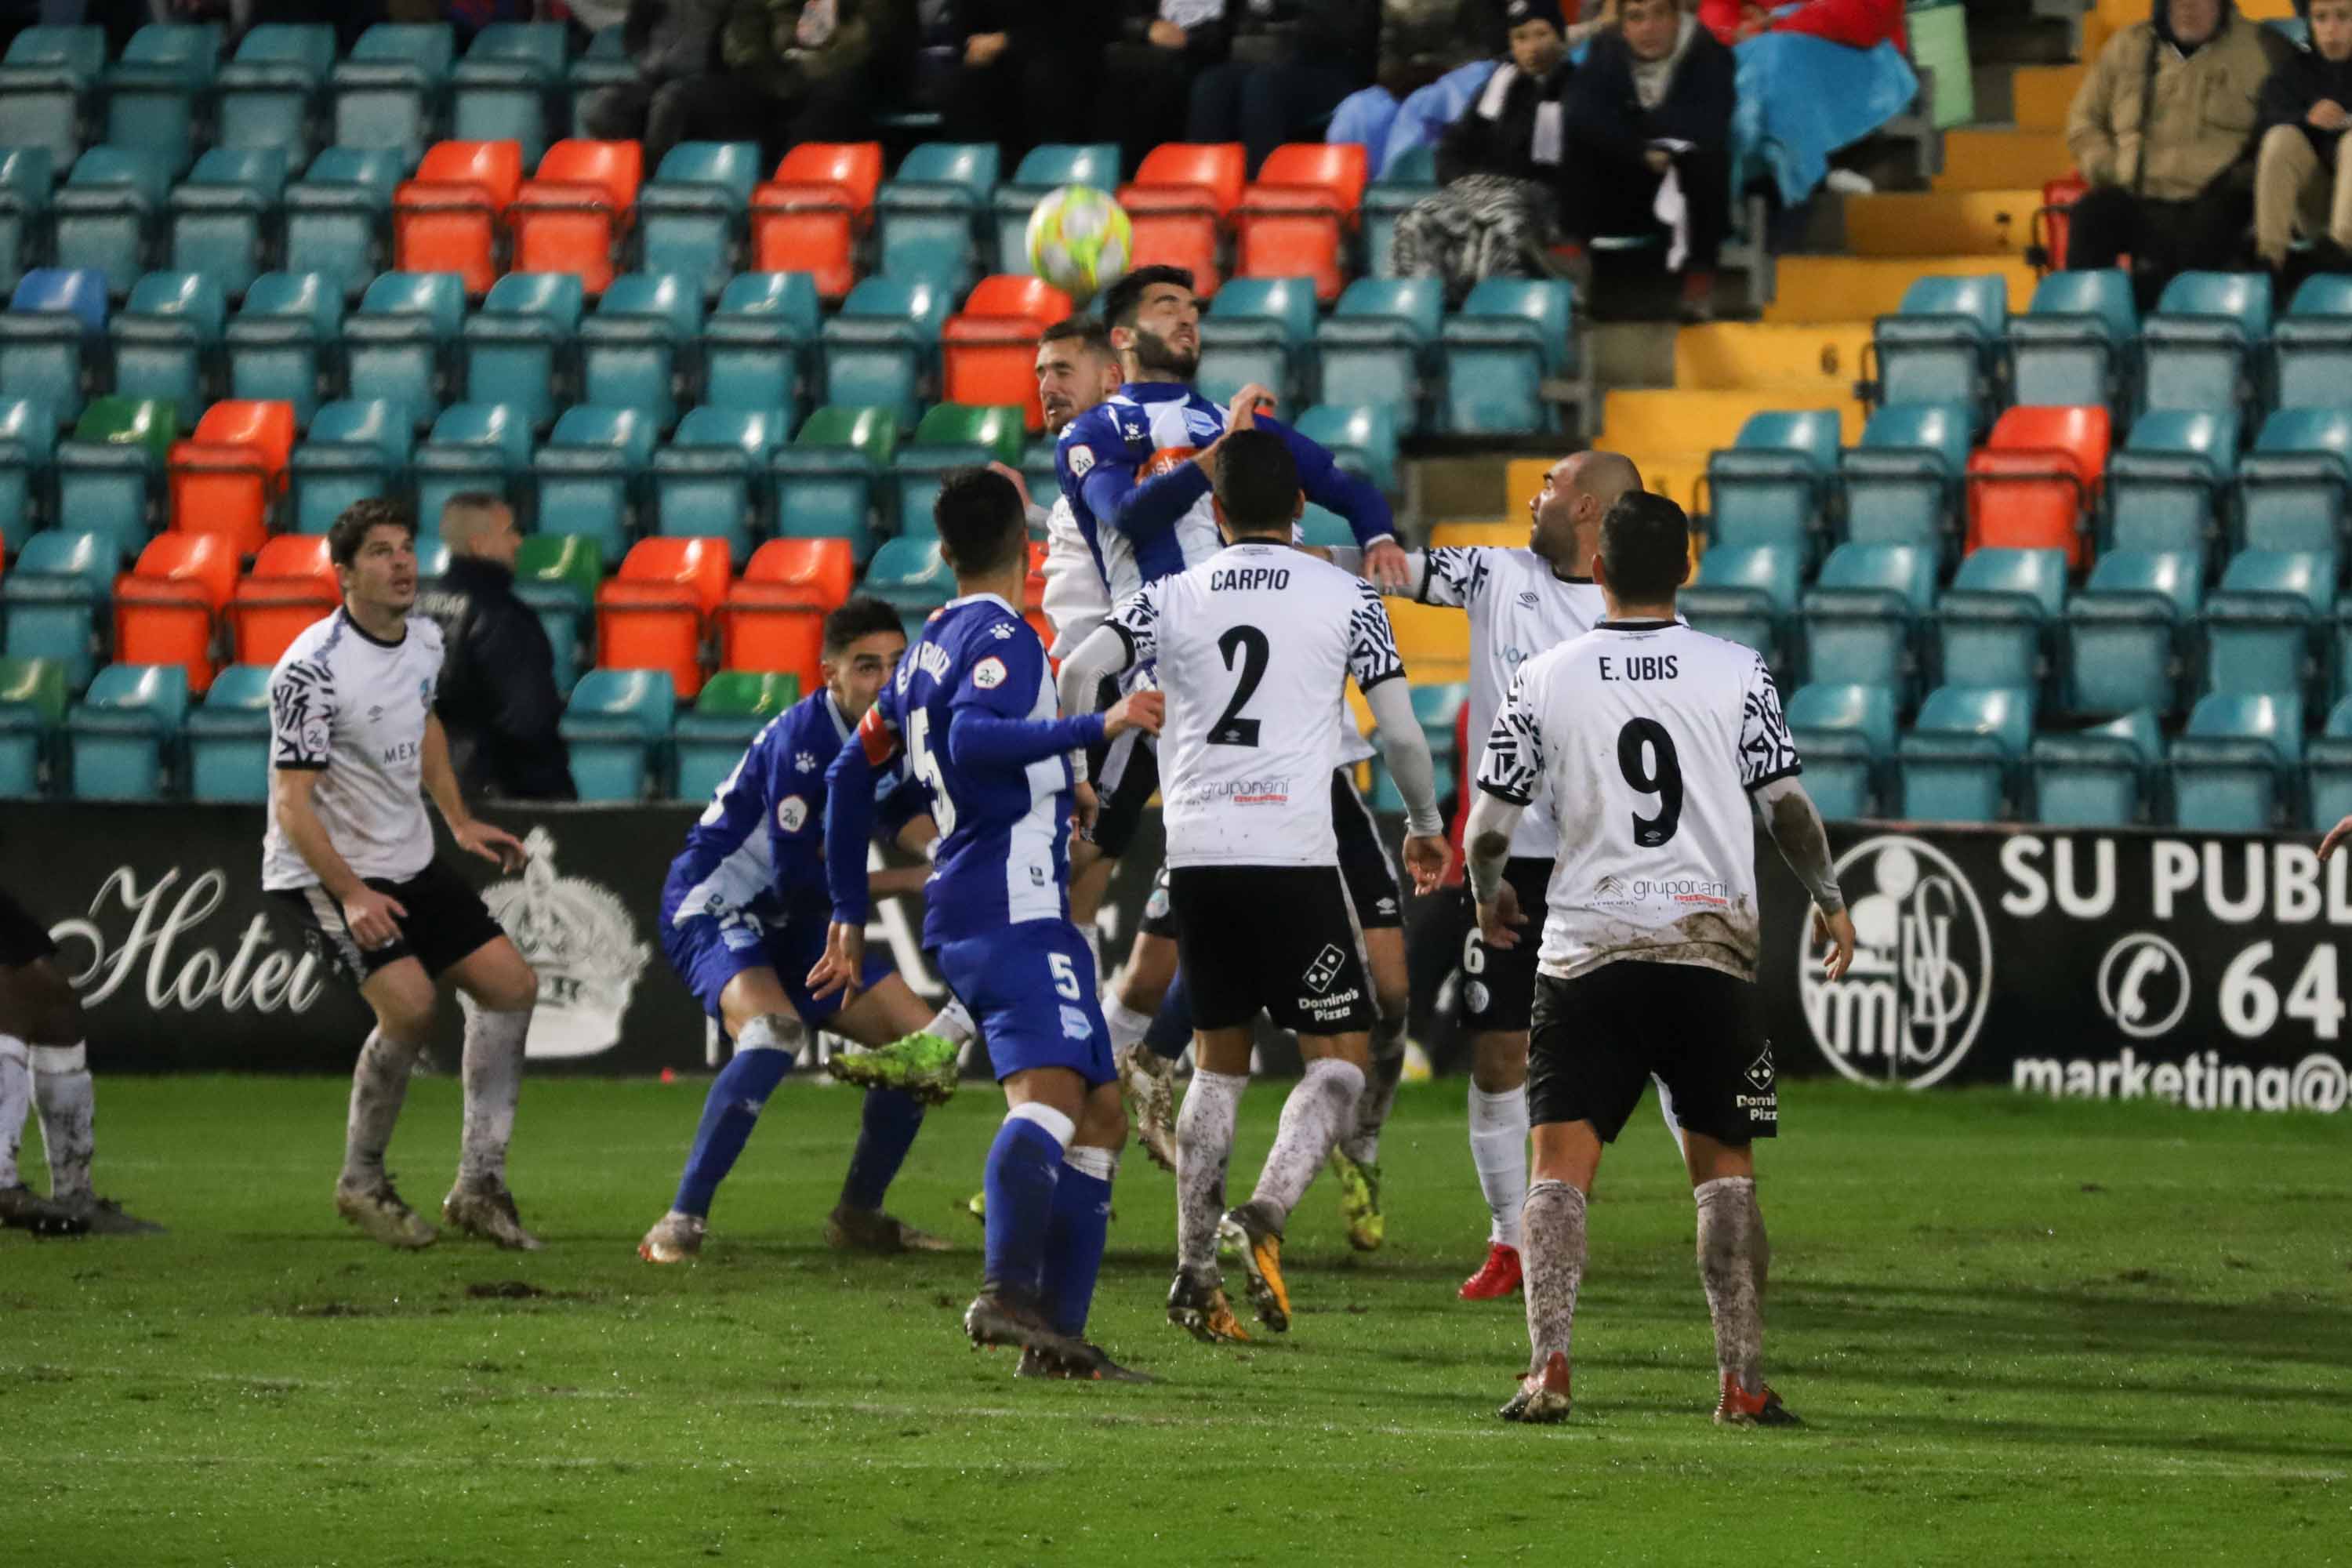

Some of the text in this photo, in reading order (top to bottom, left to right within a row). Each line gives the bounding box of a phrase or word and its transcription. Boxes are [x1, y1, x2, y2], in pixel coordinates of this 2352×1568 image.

[1210, 568, 1290, 592] CARPIO
[1207, 625, 1269, 747] 2
[1598, 655, 1679, 681] E. UBIS
[1617, 717, 1683, 848] 9
[1633, 880, 1728, 901] gruponani
[2000, 836, 2116, 919] SU
[1463, 927, 1485, 975] 6
[1047, 952, 1081, 1001] 5
[2219, 941, 2344, 1039] 64
[1298, 987, 1359, 1010] Domino's
[1314, 1006, 1351, 1022] Pizza
[1736, 1092, 1777, 1108] Domi
